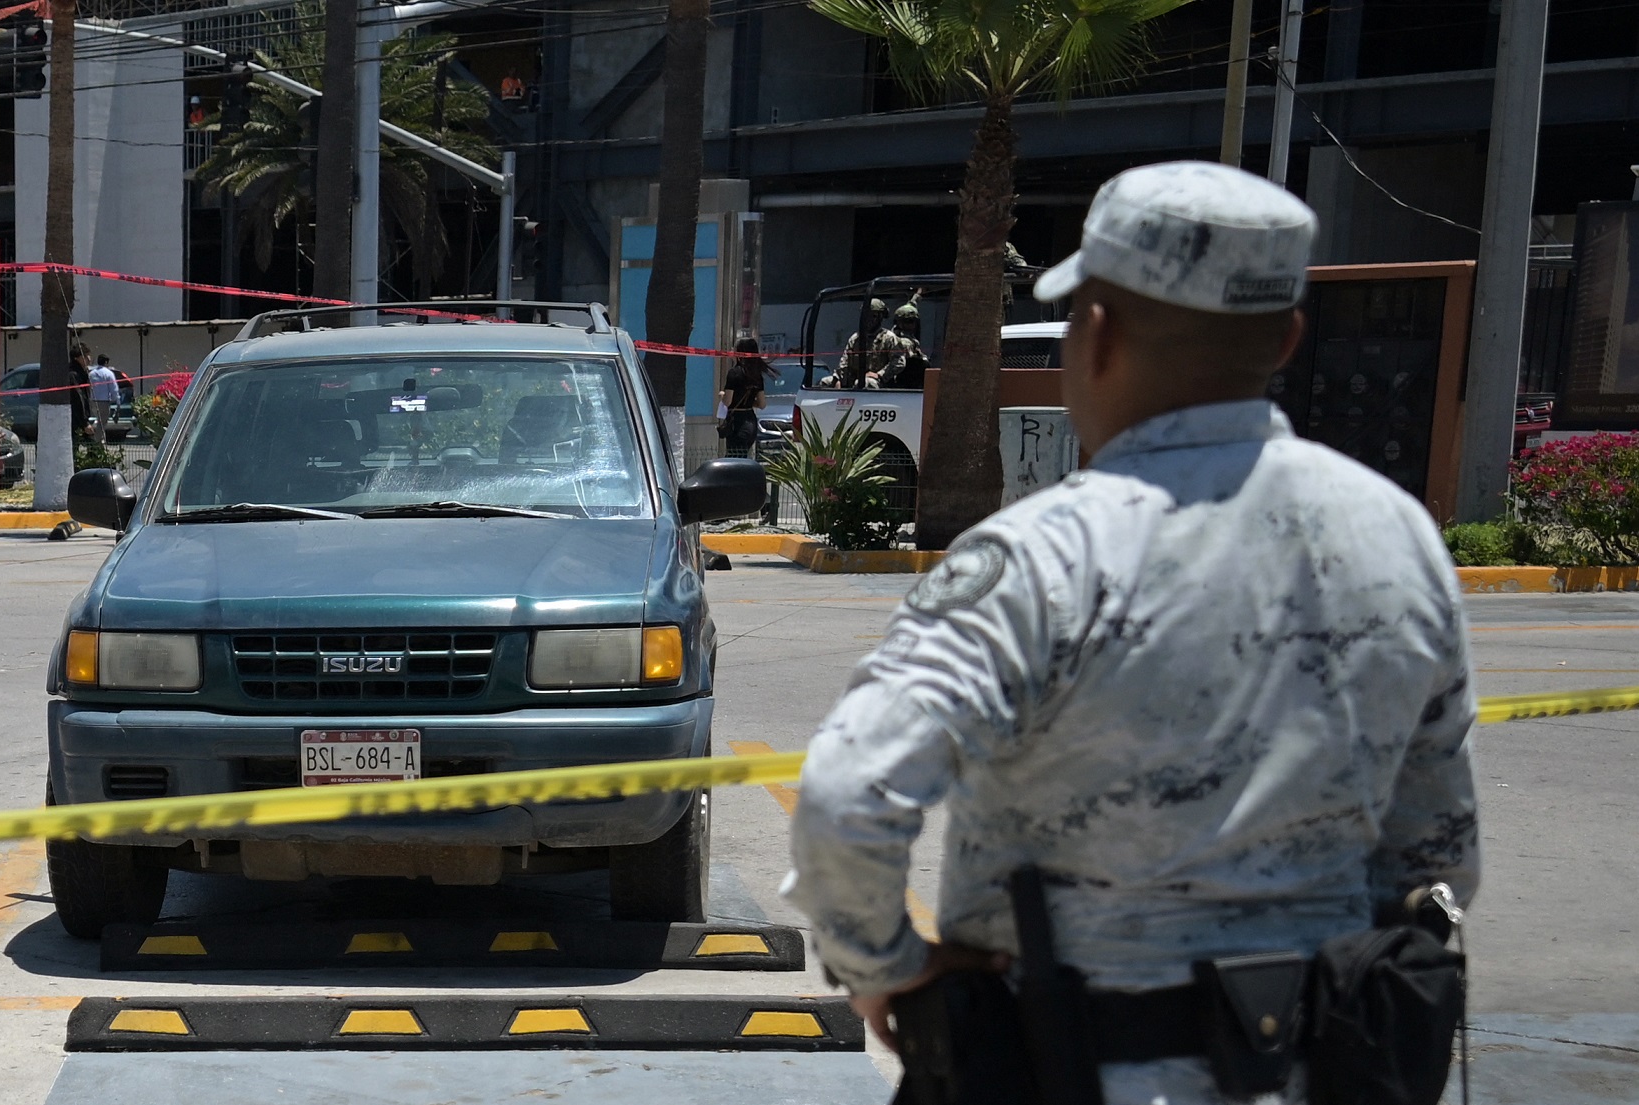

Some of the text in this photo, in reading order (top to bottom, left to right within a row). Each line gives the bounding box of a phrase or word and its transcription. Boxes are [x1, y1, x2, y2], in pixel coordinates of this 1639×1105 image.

[858, 409, 897, 422] 19589
[322, 657, 401, 673] ISUZU
[306, 746, 416, 771] BSL-684-A
